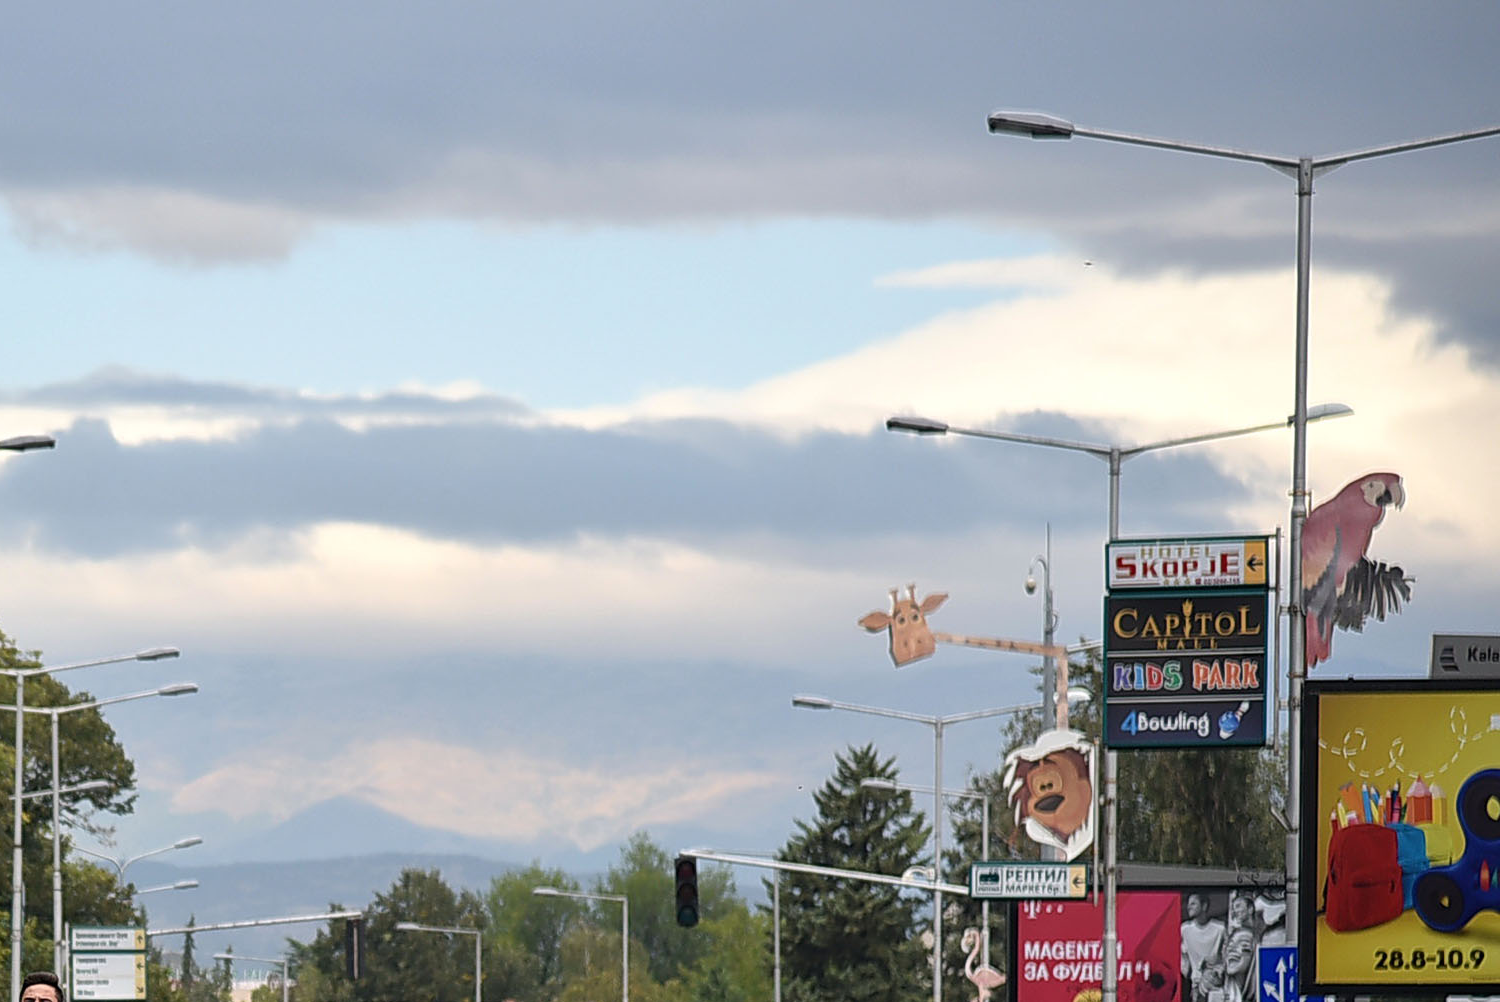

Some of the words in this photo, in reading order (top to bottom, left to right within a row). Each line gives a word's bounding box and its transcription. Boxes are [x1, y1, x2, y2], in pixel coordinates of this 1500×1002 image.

[1140, 546, 1215, 559] HOTEL
[1115, 552, 1240, 579] SKOPJE
[1113, 600, 1261, 639] CAPITOL
[1157, 637, 1218, 650] MALL
[1113, 660, 1183, 692] KIDS
[1192, 658, 1259, 692] PARK
[1120, 709, 1210, 737] 4Bowling
[1006, 868, 1067, 883] РЕПТИЛ
[1374, 949, 1485, 971] 28.8-10.9
[1024, 961, 1049, 981] ЗА
[1052, 961, 1133, 983] ФУДБЛ
